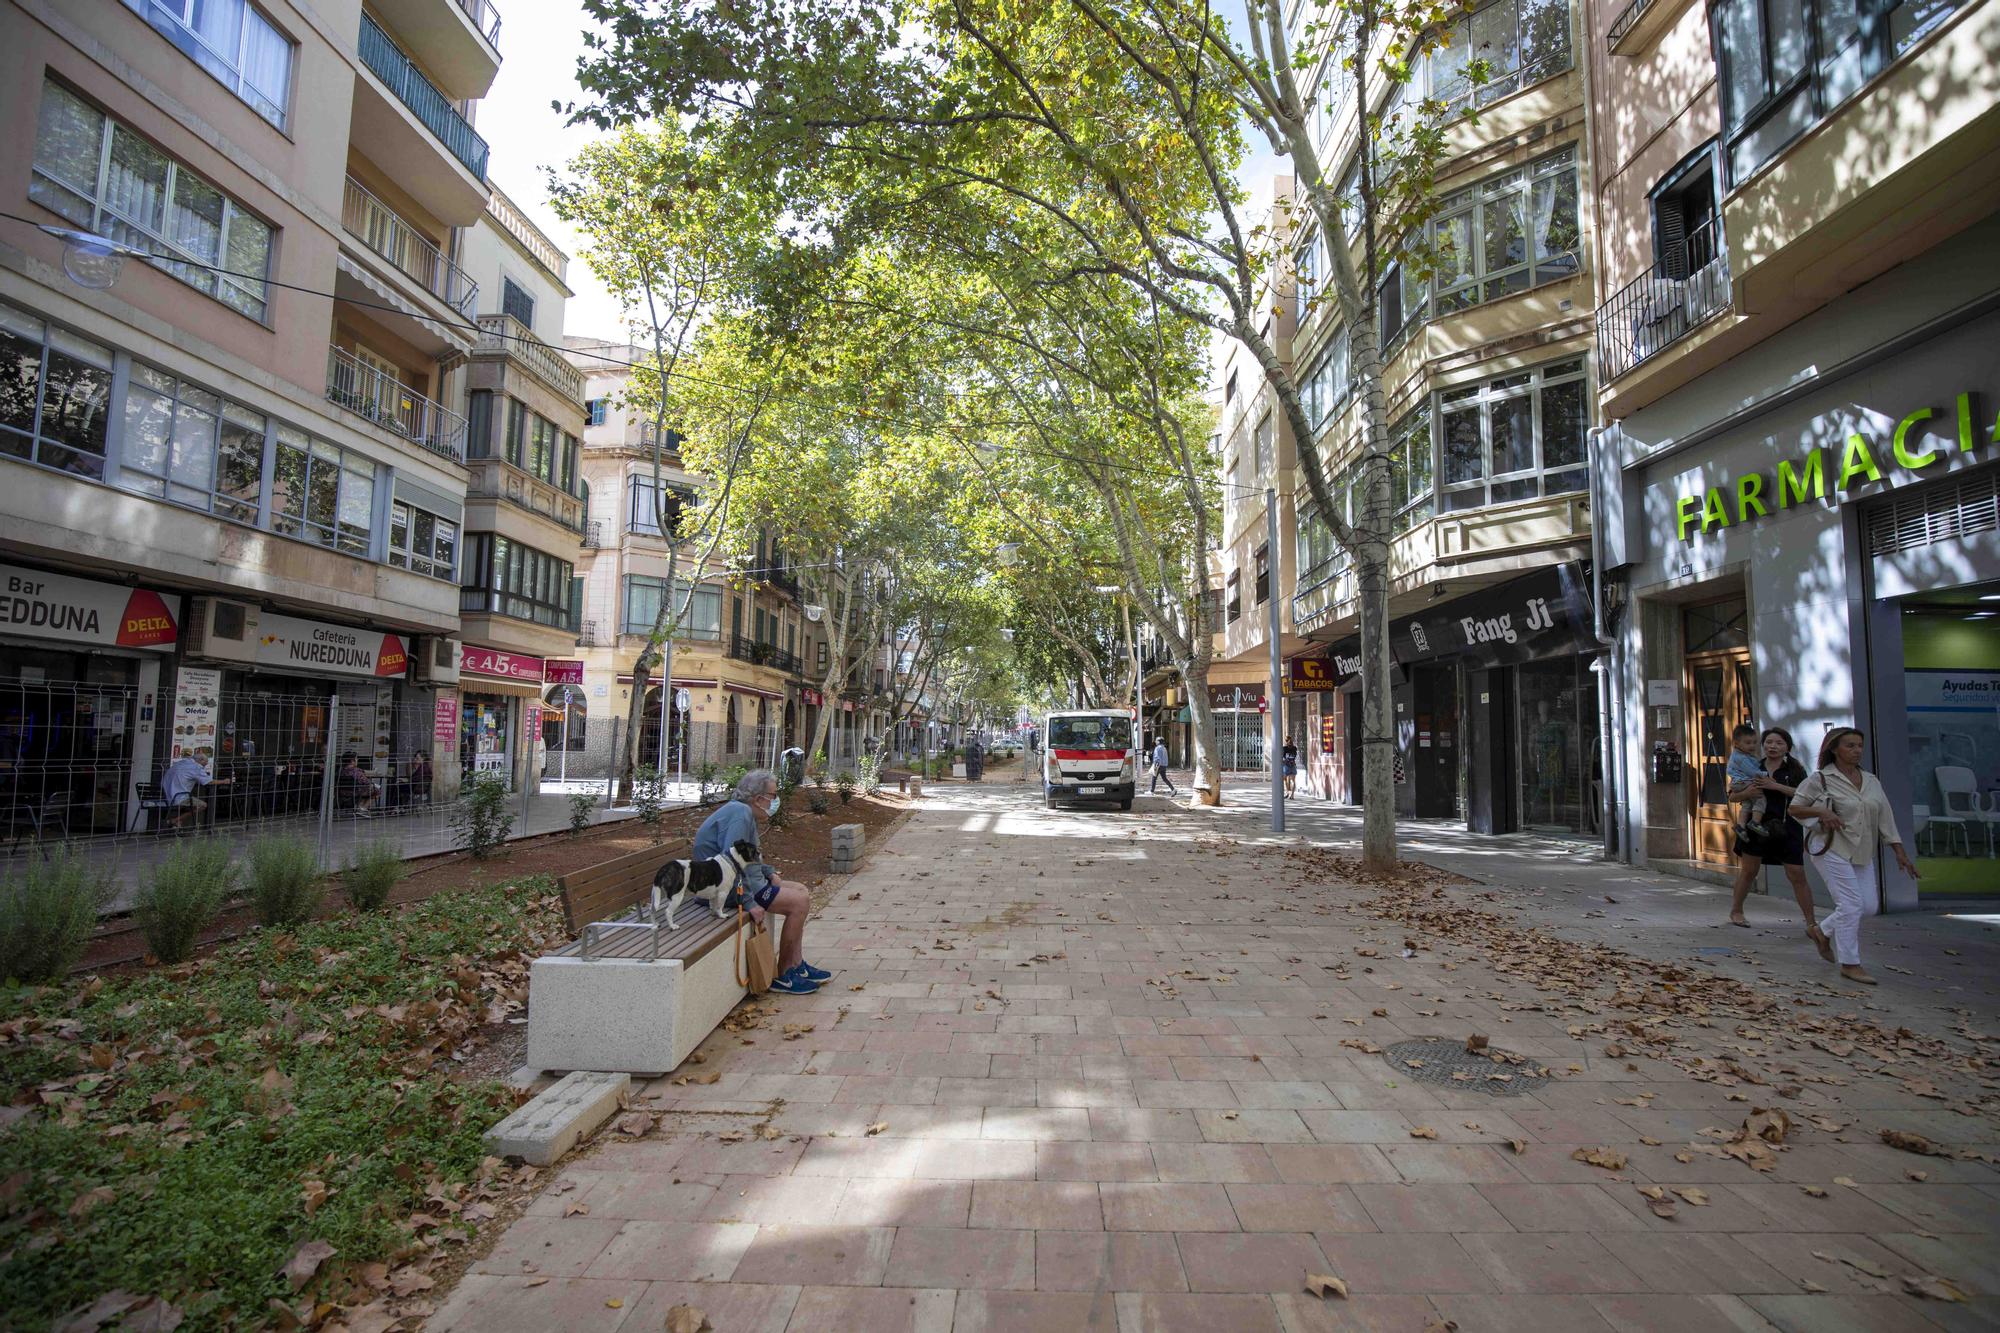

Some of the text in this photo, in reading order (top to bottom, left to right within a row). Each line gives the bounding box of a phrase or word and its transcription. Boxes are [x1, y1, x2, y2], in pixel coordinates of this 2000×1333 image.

[1676, 391, 2000, 541] FARMACI
[8, 576, 45, 595] Bar
[127, 616, 171, 632] DELTA
[1460, 598, 1554, 645] Fang Ji
[289, 640, 371, 668] NUREDDUNA
[381, 654, 404, 666] DELTA
[1294, 680, 1334, 688] TABACOS
[1942, 680, 1989, 693] Ayudas
[1216, 692, 1257, 703] Art Viu
